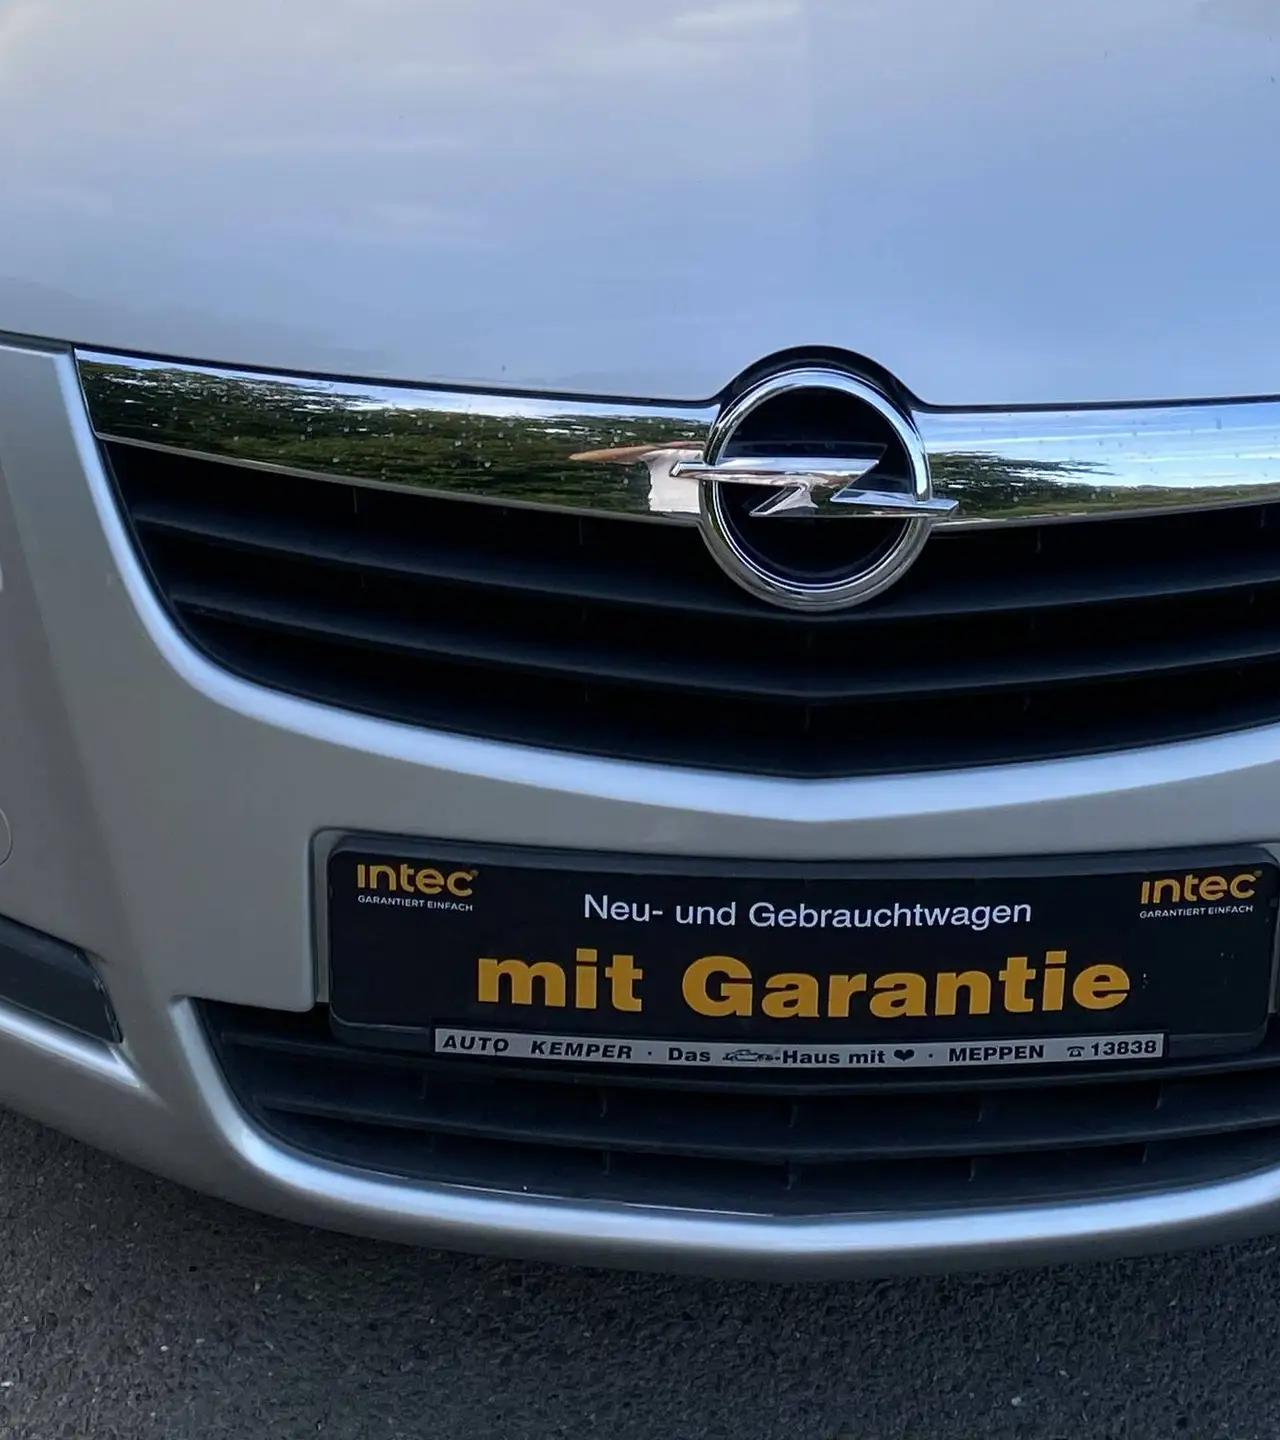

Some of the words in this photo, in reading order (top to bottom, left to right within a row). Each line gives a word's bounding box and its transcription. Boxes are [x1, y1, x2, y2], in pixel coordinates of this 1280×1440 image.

[357, 863, 476, 897] intec
[1141, 873, 1258, 904] intec
[357, 895, 425, 908] GARANTIERT
[427, 900, 473, 912] EINFACH
[584, 893, 664, 922] Neu-
[676, 900, 736, 927] und
[748, 900, 1033, 932] Gebrauchtwagen
[1139, 907, 1206, 919] GARANTIERT
[1208, 904, 1254, 915] EINFACH
[478, 947, 643, 1013] mit
[682, 949, 1131, 1019] Garantie
[442, 1035, 510, 1054] AUTO
[530, 1040, 633, 1060] KEMPER
[668, 1047, 711, 1063] Das
[848, 1049, 886, 1065] mit
[948, 1045, 1045, 1062] MEPPEN
[1091, 1040, 1157, 1057] 13838
